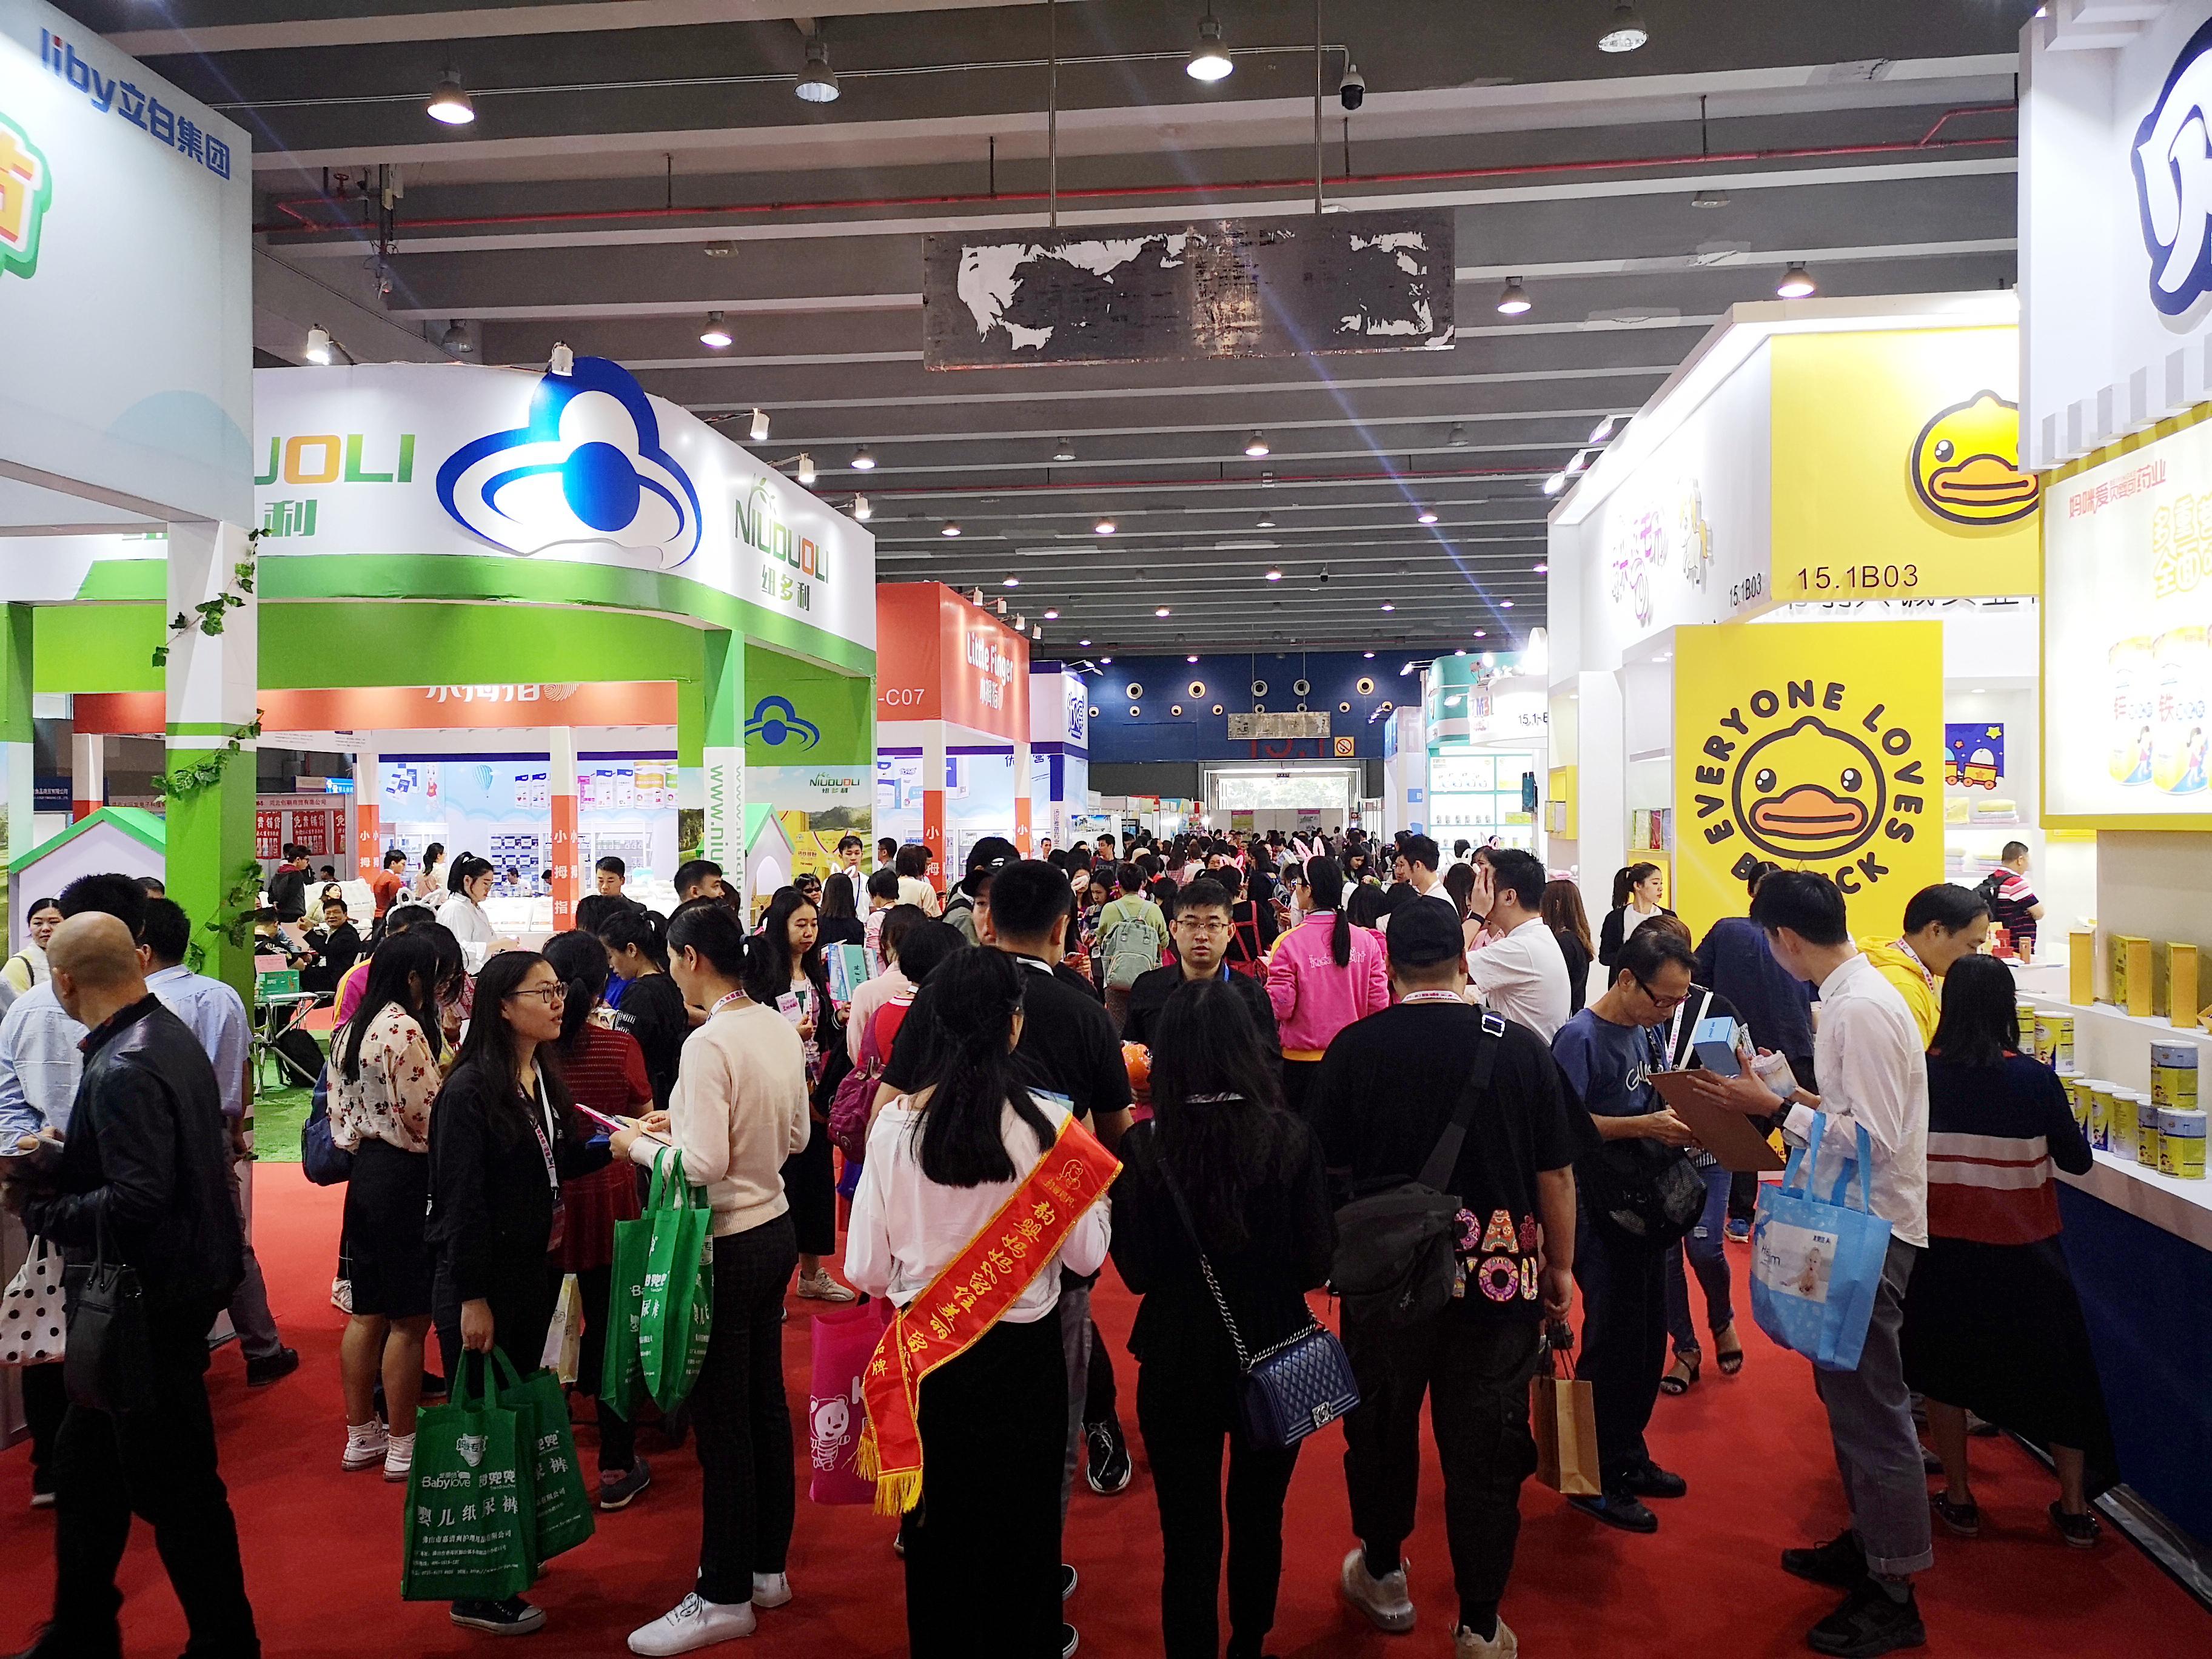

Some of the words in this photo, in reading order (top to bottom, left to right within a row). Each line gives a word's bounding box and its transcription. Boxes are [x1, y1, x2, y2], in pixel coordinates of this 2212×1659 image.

[734, 498, 829, 584] NIUDUOLI
[761, 565, 810, 611] 纽多利
[1729, 572, 1762, 608] 15.1B03
[1797, 564, 1919, 591] 15.1B03
[967, 631, 990, 674] Little
[990, 644, 1013, 687] Finger
[1695, 679, 1845, 845] EVERYONE
[1862, 703, 1925, 843] LOVES
[554, 829, 568, 915] 小拇指
[421, 1475, 471, 1490] Babylove
[417, 1495, 518, 1527] 婴儿纸尿裤
